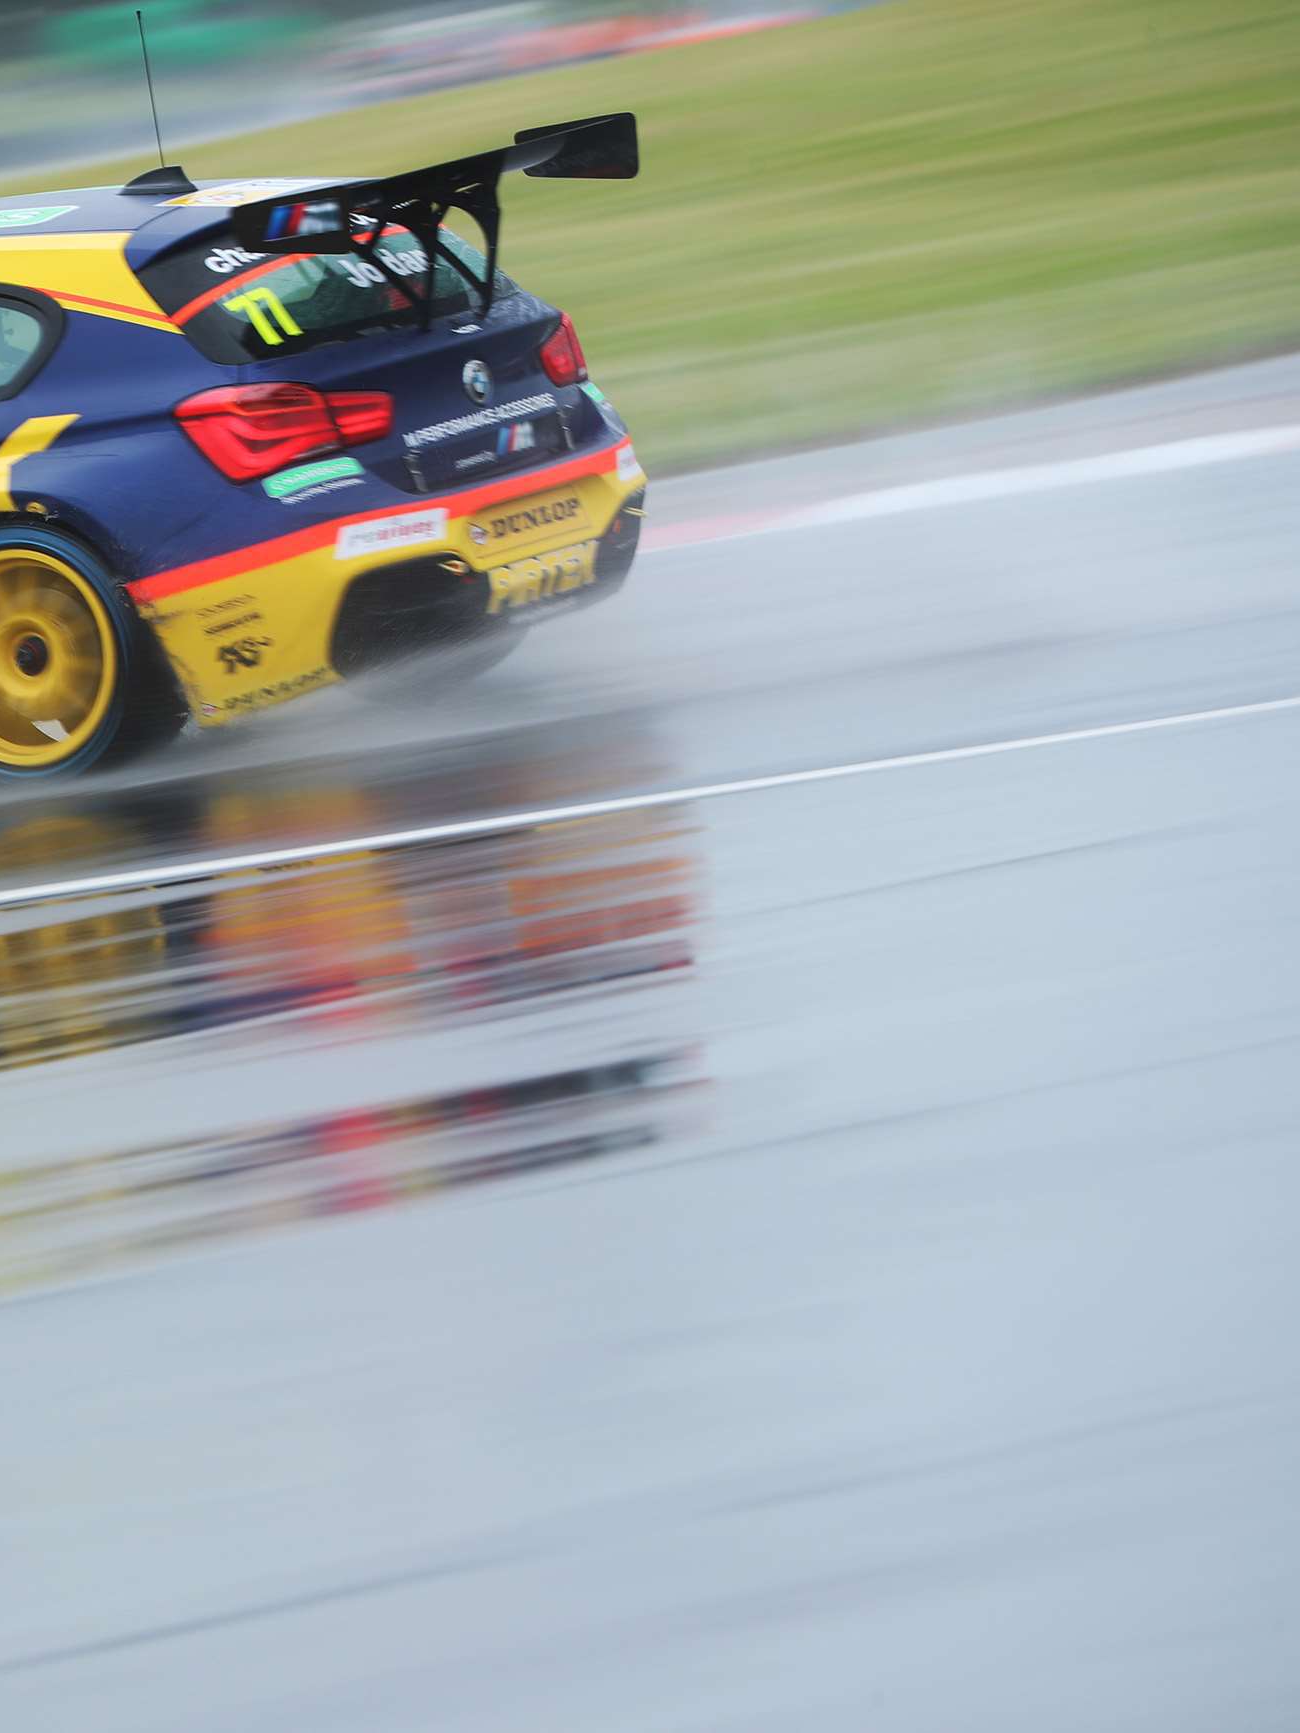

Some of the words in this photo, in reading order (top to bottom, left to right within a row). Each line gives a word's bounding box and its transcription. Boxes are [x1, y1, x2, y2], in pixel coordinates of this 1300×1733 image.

[339, 247, 431, 288] Jodan
[222, 287, 304, 346] 77
[490, 497, 582, 539] DUNLOP
